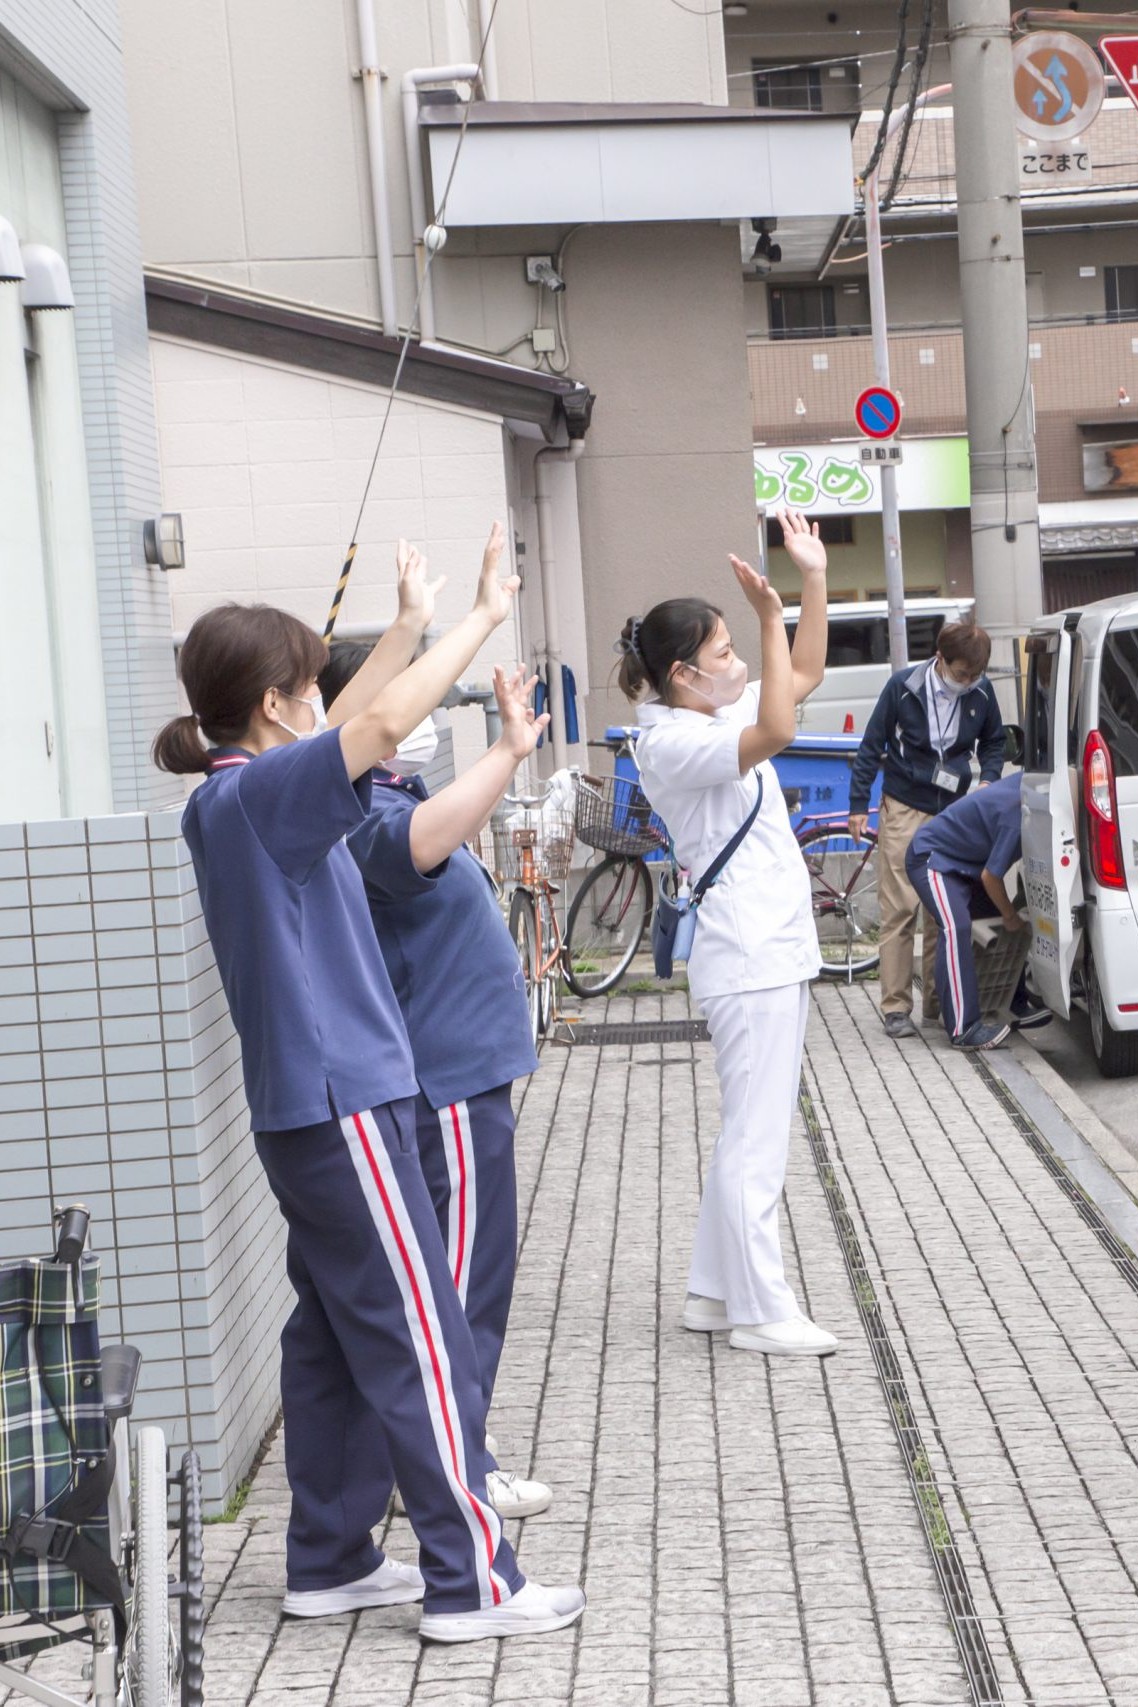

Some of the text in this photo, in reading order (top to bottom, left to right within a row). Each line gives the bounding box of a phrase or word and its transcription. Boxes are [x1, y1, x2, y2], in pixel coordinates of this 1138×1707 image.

[1022, 152, 1089, 174] ここまで
[861, 447, 901, 460] 自動車
